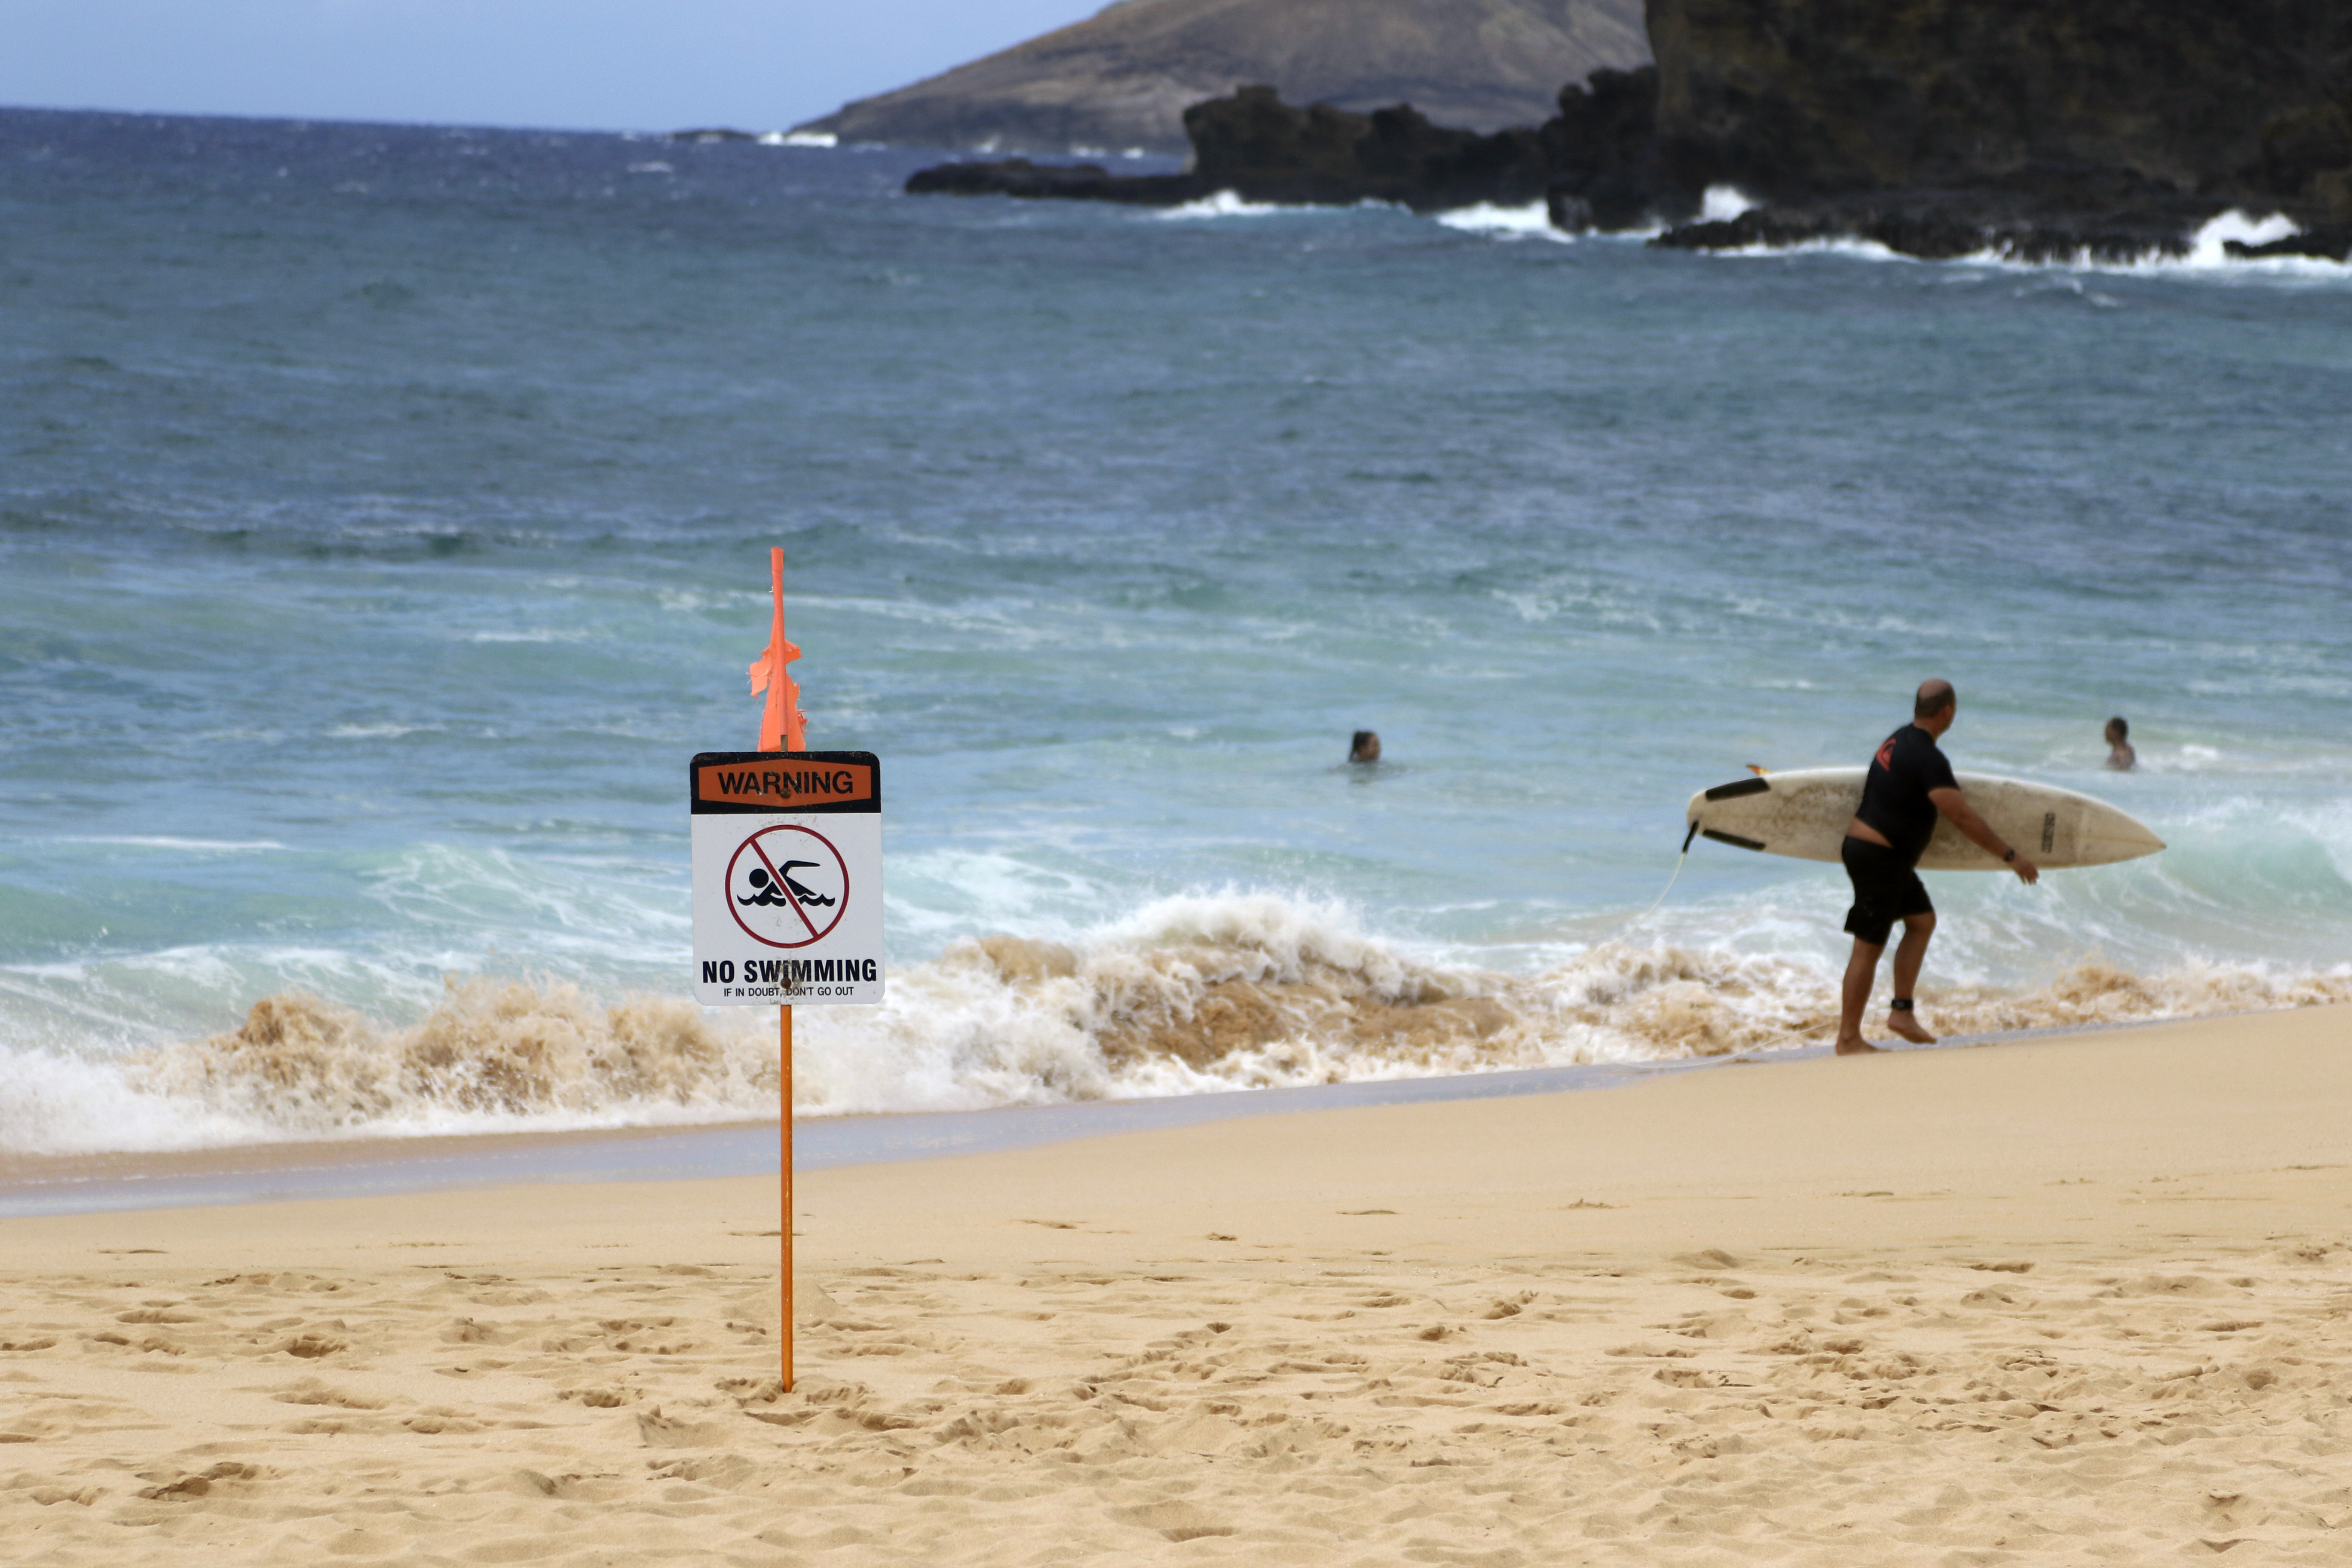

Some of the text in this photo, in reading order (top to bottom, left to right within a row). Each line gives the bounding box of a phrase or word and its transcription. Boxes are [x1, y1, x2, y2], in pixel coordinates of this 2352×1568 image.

[717, 771, 853, 794] WARNING
[702, 959, 877, 983] NO SWIMMING
[724, 986, 854, 998] IF IN DOUBT, DON'T GO OUT
